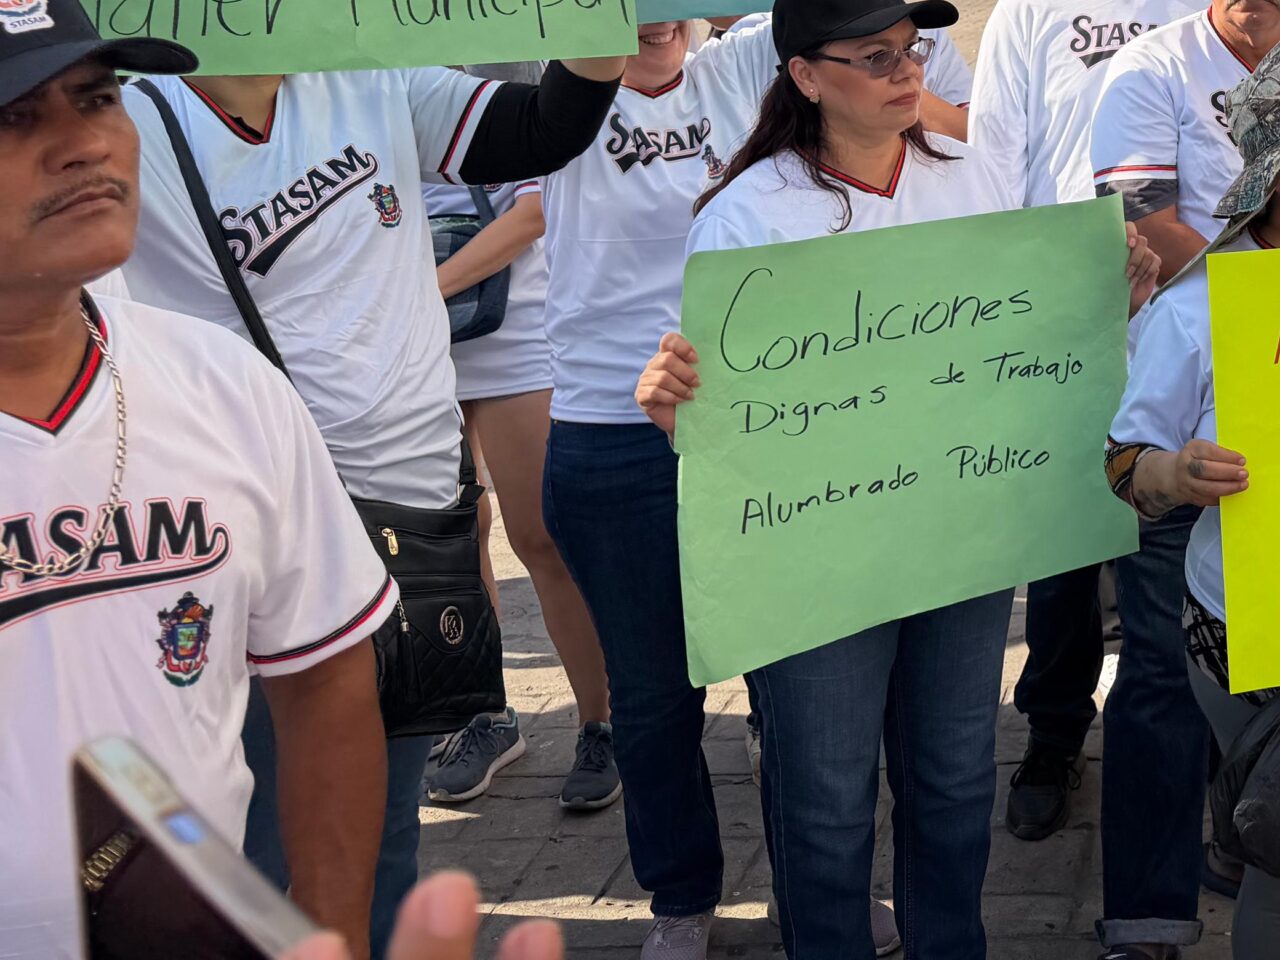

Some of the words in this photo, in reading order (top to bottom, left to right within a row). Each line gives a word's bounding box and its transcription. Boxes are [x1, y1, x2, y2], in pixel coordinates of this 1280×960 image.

[9, 15, 47, 29] STASAM
[719, 266, 1035, 373] Condiciones
[730, 385, 888, 437] Dignas
[930, 362, 966, 385] de
[983, 351, 1084, 384] Trabajo
[741, 463, 919, 535] Alumbrado
[946, 443, 1051, 479] Público
